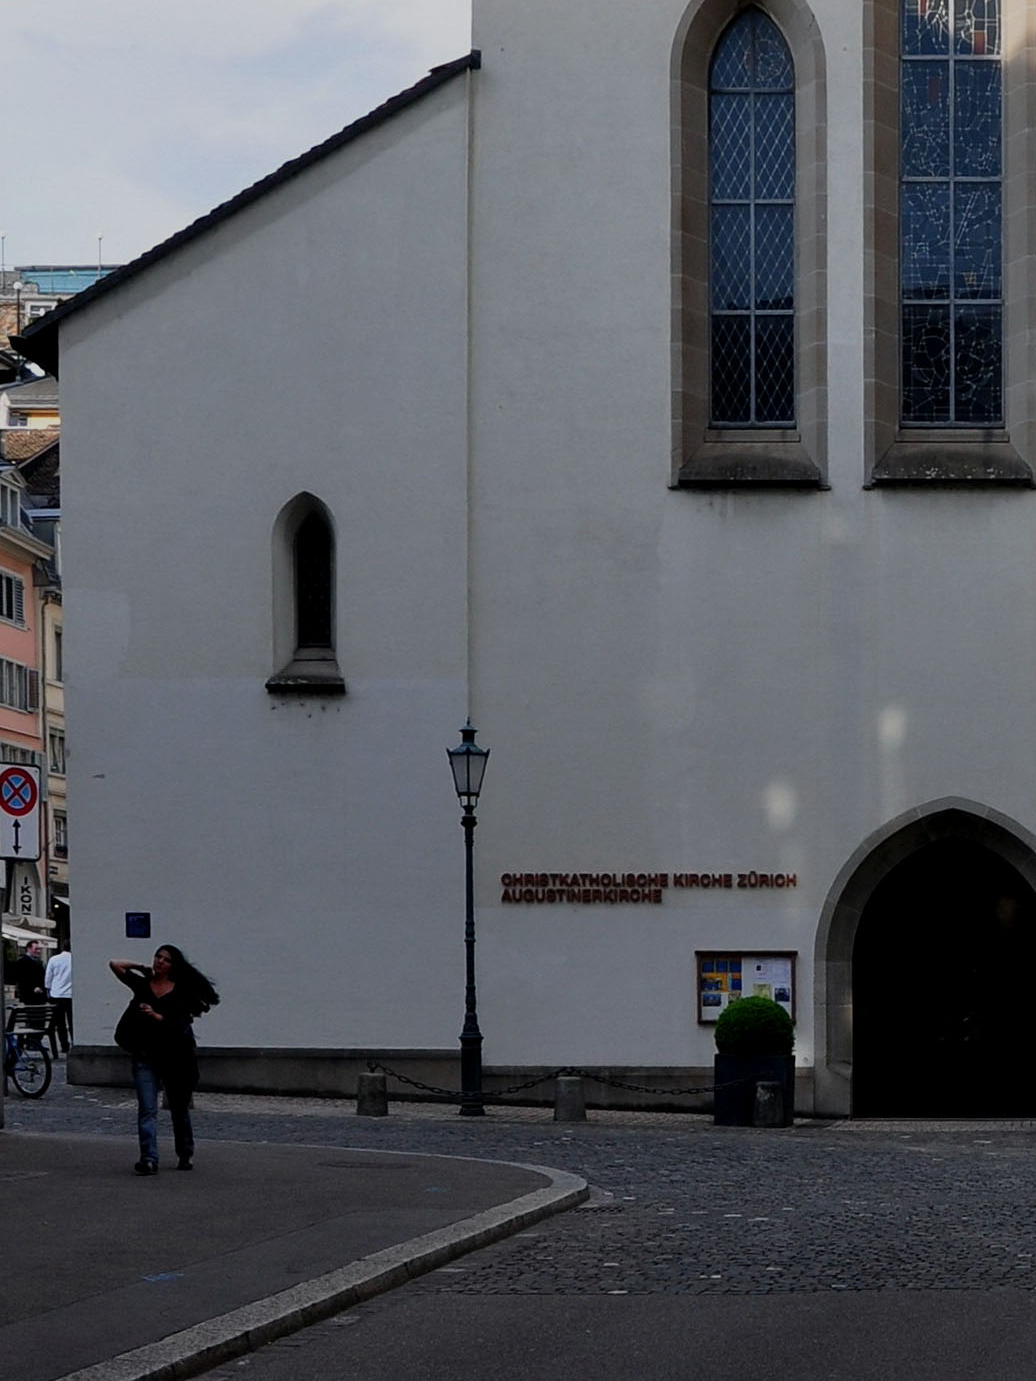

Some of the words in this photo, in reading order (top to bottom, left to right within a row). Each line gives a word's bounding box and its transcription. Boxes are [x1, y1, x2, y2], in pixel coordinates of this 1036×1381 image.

[501, 872, 669, 888] CHRISTKATHOLISCHE
[673, 872, 733, 888] KIRCHE
[736, 870, 797, 888] ZÜRICH
[501, 888, 663, 904] AUGUSTINERKIRCHE
